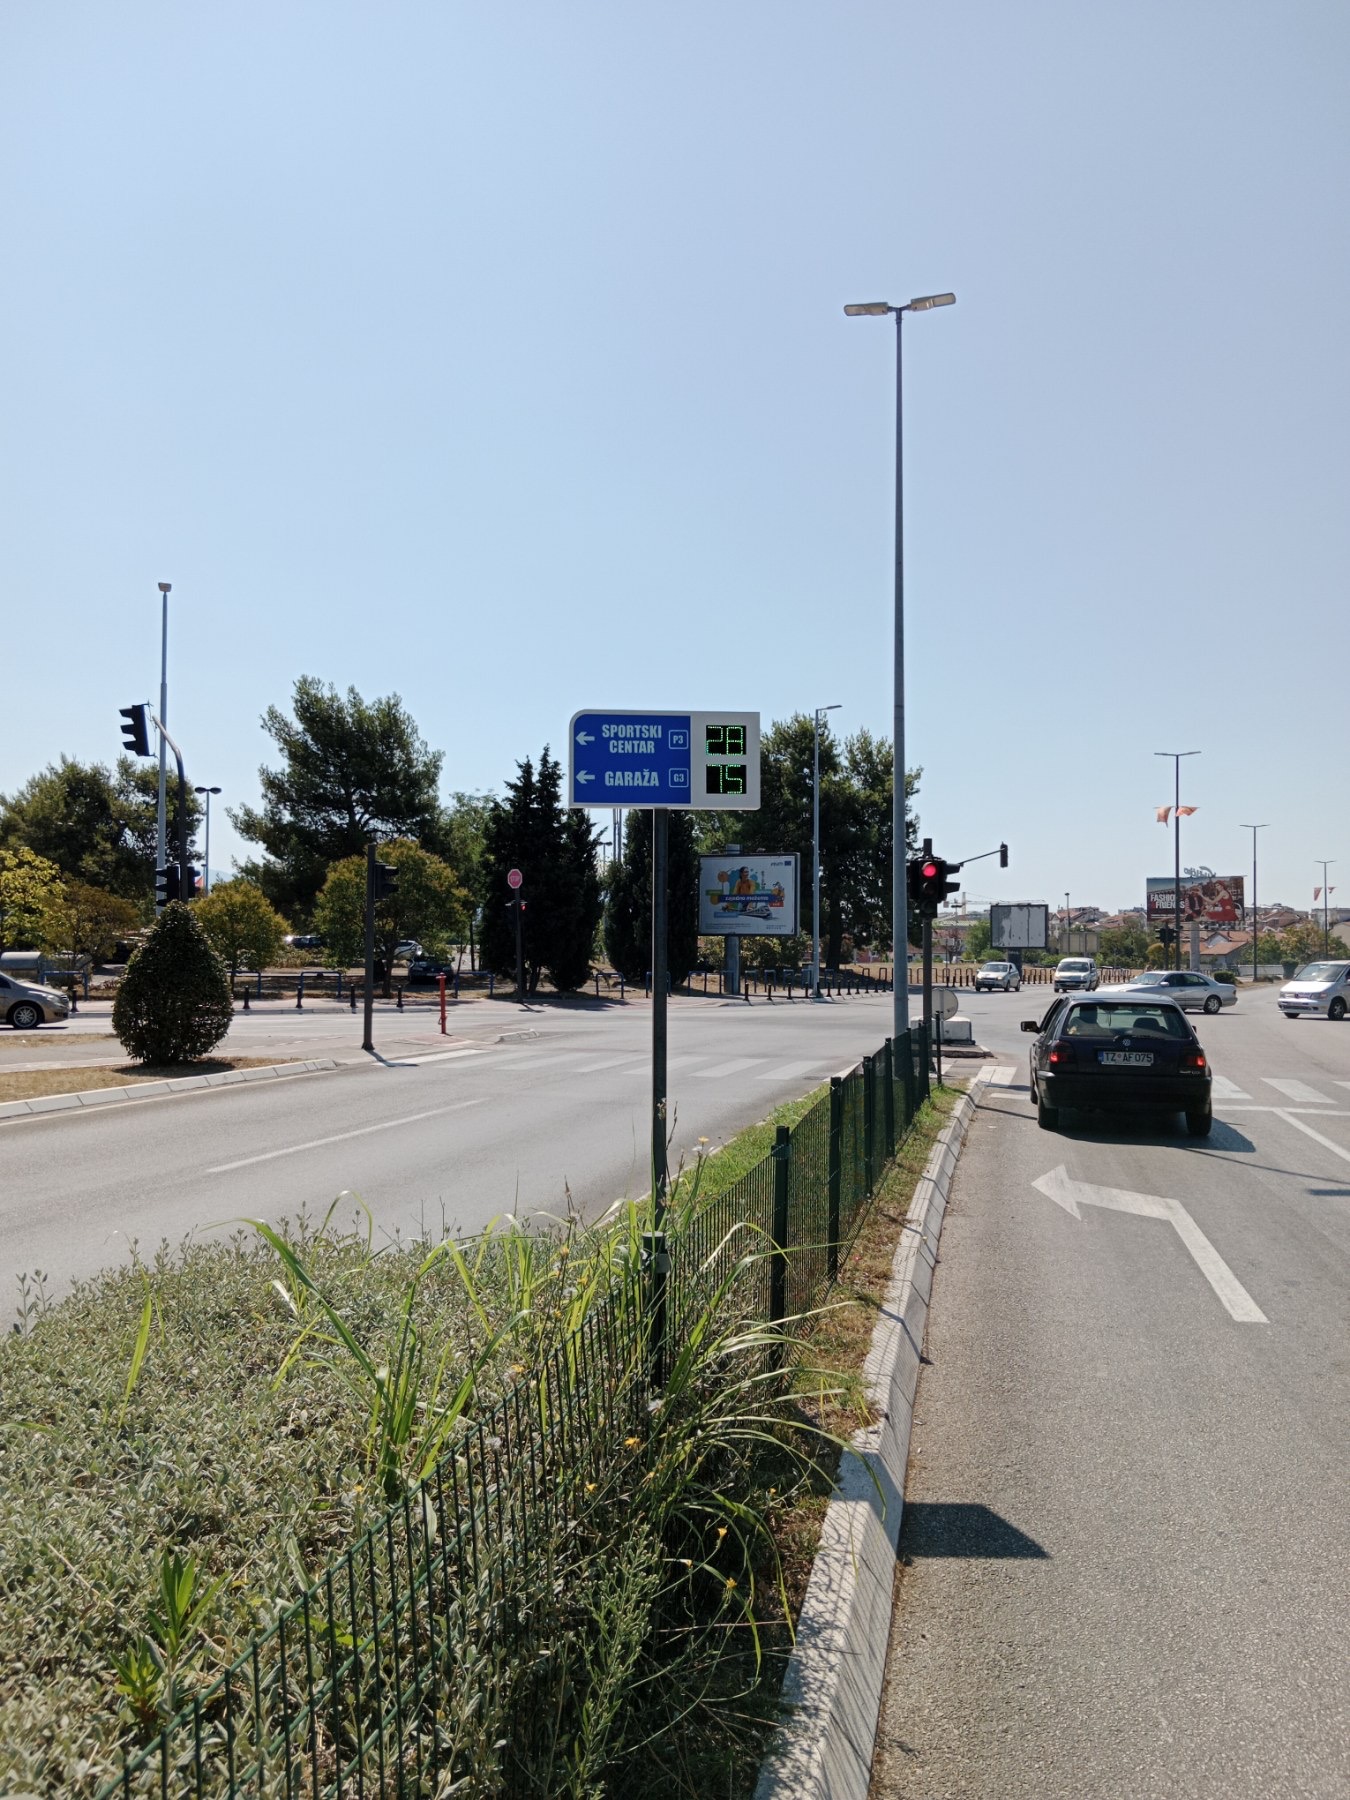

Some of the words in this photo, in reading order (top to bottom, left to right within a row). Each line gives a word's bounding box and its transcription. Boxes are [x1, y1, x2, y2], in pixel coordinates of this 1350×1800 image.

[602, 724, 662, 738] SPORTSKI
[672, 735, 684, 745] P3
[706, 726, 744, 756] 28
[609, 740, 655, 753] CENTAR
[604, 769, 660, 787] GARAŽA
[673, 773, 685, 783] G3
[706, 764, 743, 795] 75
[1151, 894, 1176, 902] FASHIO
[1155, 901, 1185, 909] FRIENS
[1104, 1052, 1117, 1062] TZ
